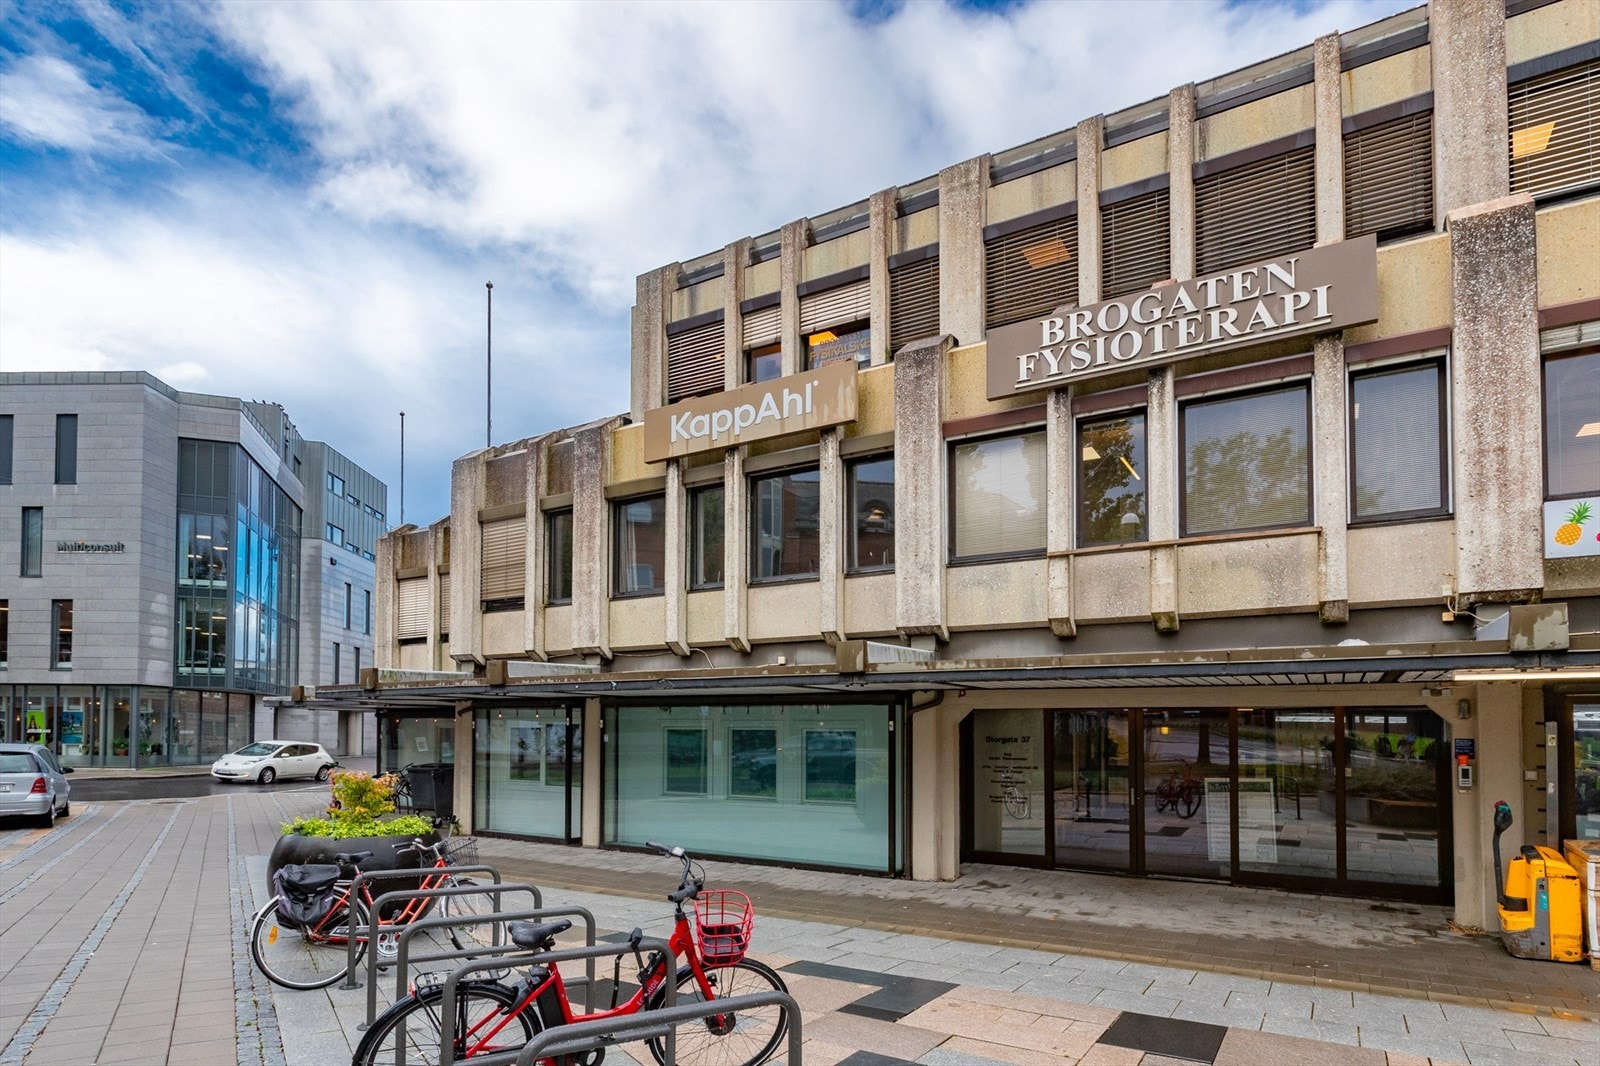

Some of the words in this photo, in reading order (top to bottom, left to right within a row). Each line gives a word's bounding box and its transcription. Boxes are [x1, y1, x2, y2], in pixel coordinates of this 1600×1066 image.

[1039, 257, 1299, 348] BROGATEN
[1015, 284, 1333, 383] FYSIOTERAPI
[670, 382, 813, 443] KappAhl
[57, 541, 124, 552] Multiconsult
[985, 736, 1018, 744] Storgata
[636, 979, 661, 1006] ECRIDE
